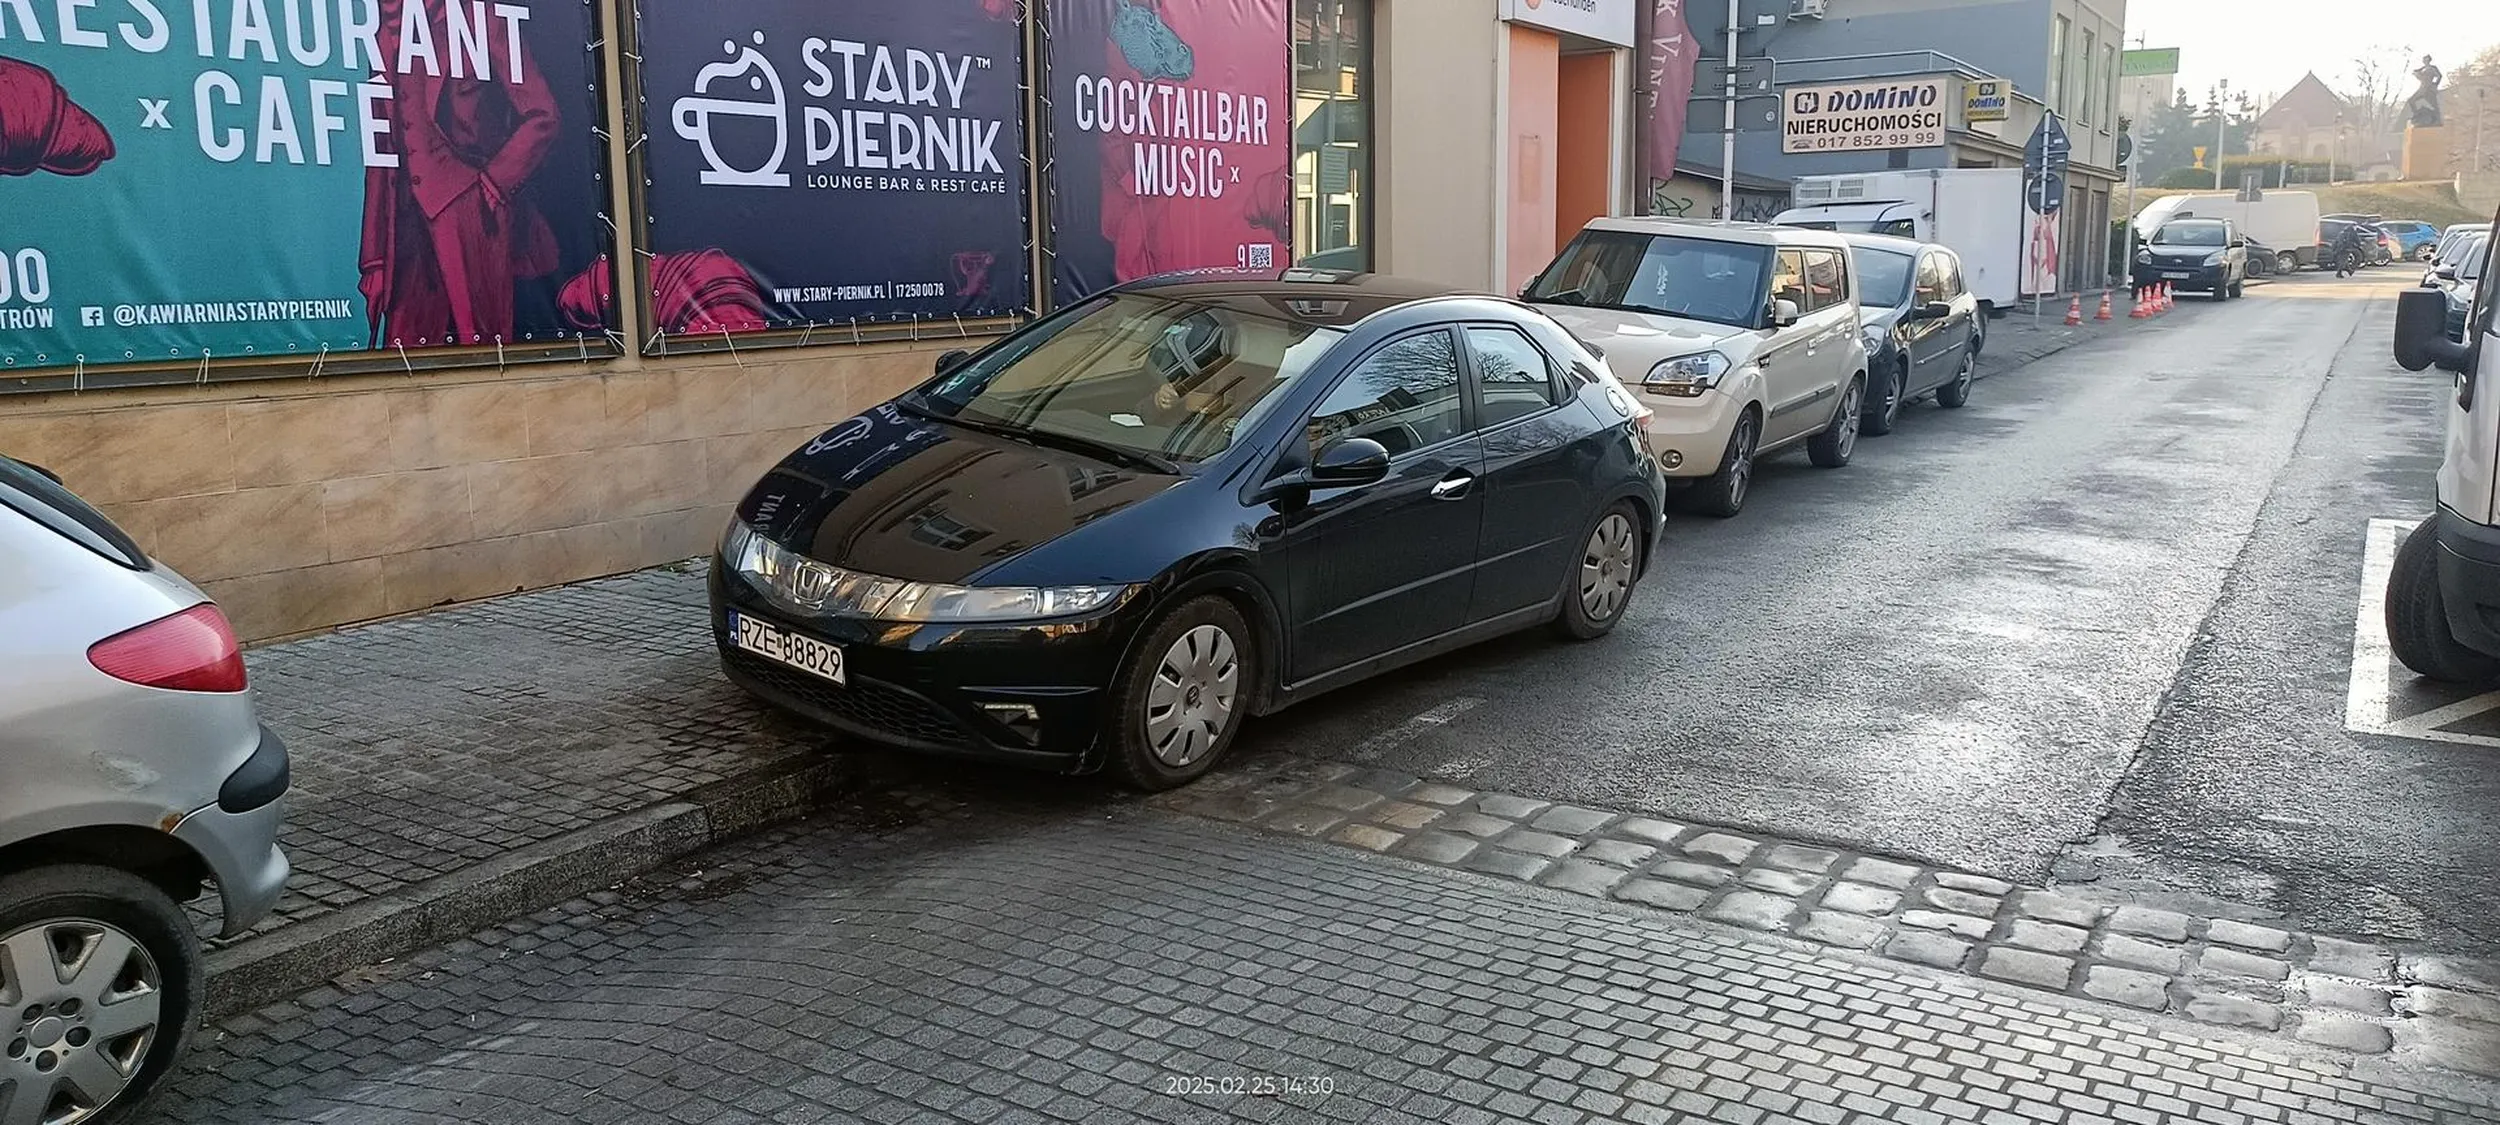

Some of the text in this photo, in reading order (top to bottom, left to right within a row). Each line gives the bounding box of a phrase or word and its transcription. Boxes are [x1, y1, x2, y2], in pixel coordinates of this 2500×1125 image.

[802, 37, 971, 109] STARY
[194, 70, 399, 168] CAFÉ
[1075, 74, 1269, 146] COCKTAILBAR
[1787, 109, 1942, 136] NIERUCHOMOŚCI
[804, 106, 1004, 174] PIERNIK
[1817, 132, 1936, 149] 017 852 99 99
[807, 174, 1006, 194] LOUNGE BAR & REST CAFÉ
[1134, 142, 1224, 199] MUSIC
[113, 300, 352, 327] @KAWIARNIASTARYPIERNIK
[773, 284, 886, 303] WWW.STARY-PIERNIK.PL
[740, 616, 841, 678] RZE 88829
